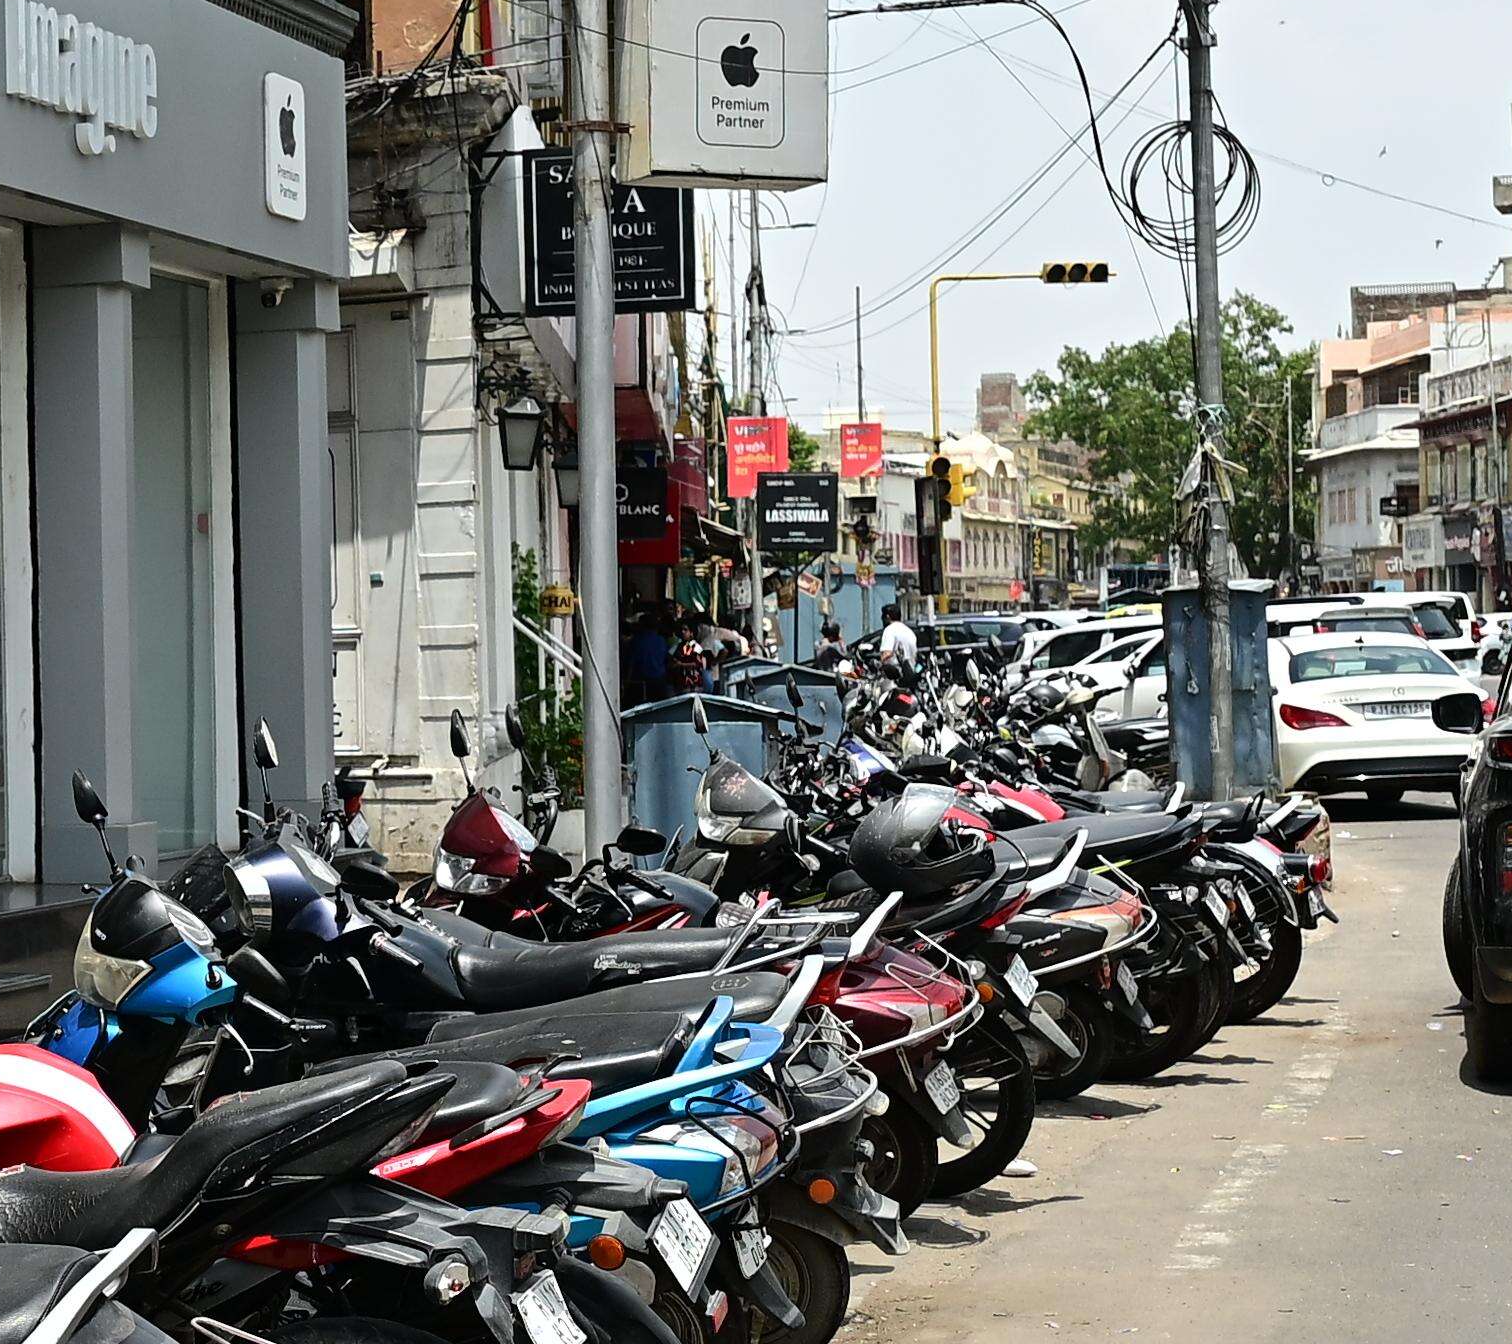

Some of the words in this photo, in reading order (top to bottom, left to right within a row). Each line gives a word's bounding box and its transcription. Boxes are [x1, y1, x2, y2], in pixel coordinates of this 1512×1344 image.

[711, 96, 770, 114] Premium
[716, 113, 766, 130] Partner
[277, 163, 300, 183] Premium
[279, 182, 299, 201] Partner
[765, 509, 830, 523] LASSIWALA
[542, 595, 571, 608] CHAI
